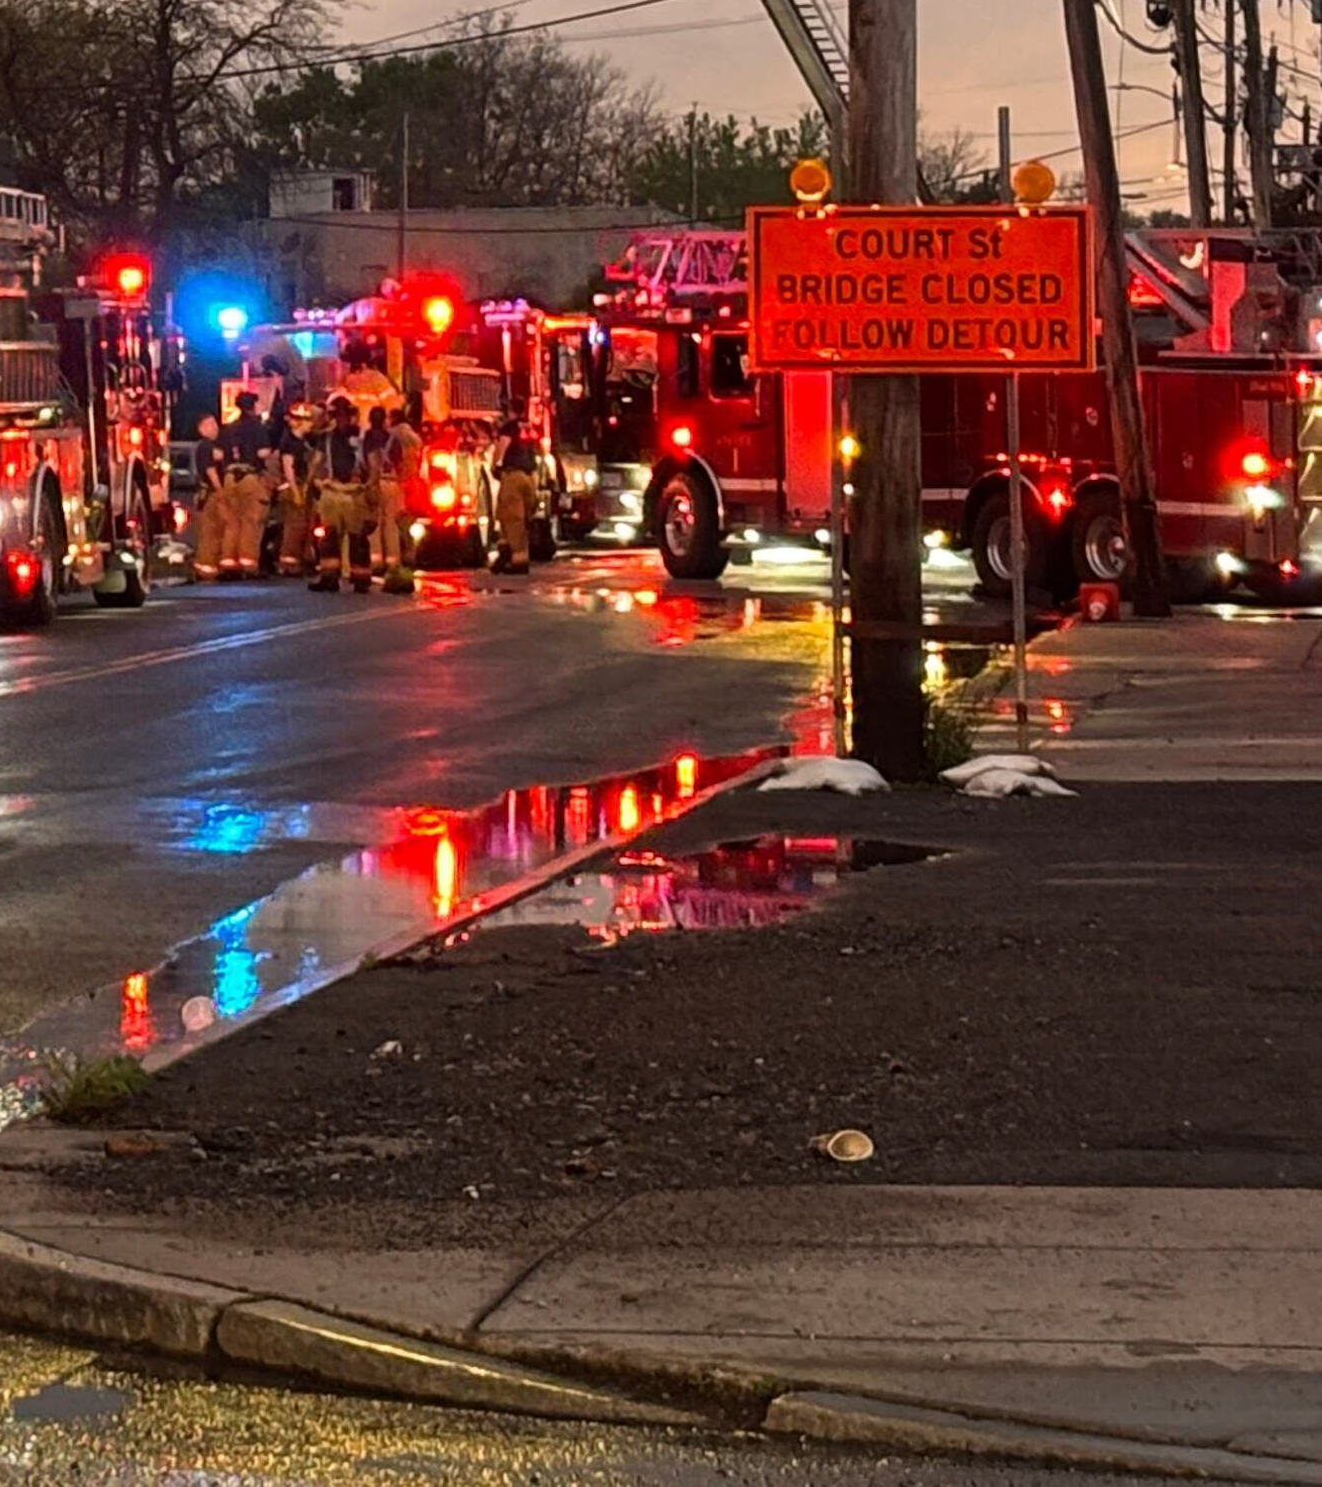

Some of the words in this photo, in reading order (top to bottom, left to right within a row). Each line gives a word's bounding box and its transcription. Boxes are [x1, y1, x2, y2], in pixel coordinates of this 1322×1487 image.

[835, 229, 955, 259] COURT
[968, 228, 1003, 259] St
[777, 274, 906, 304] BRIDGE
[921, 273, 1062, 304] CLOSED
[772, 320, 915, 350] FOLLOW
[927, 319, 1069, 350] DETOUR
